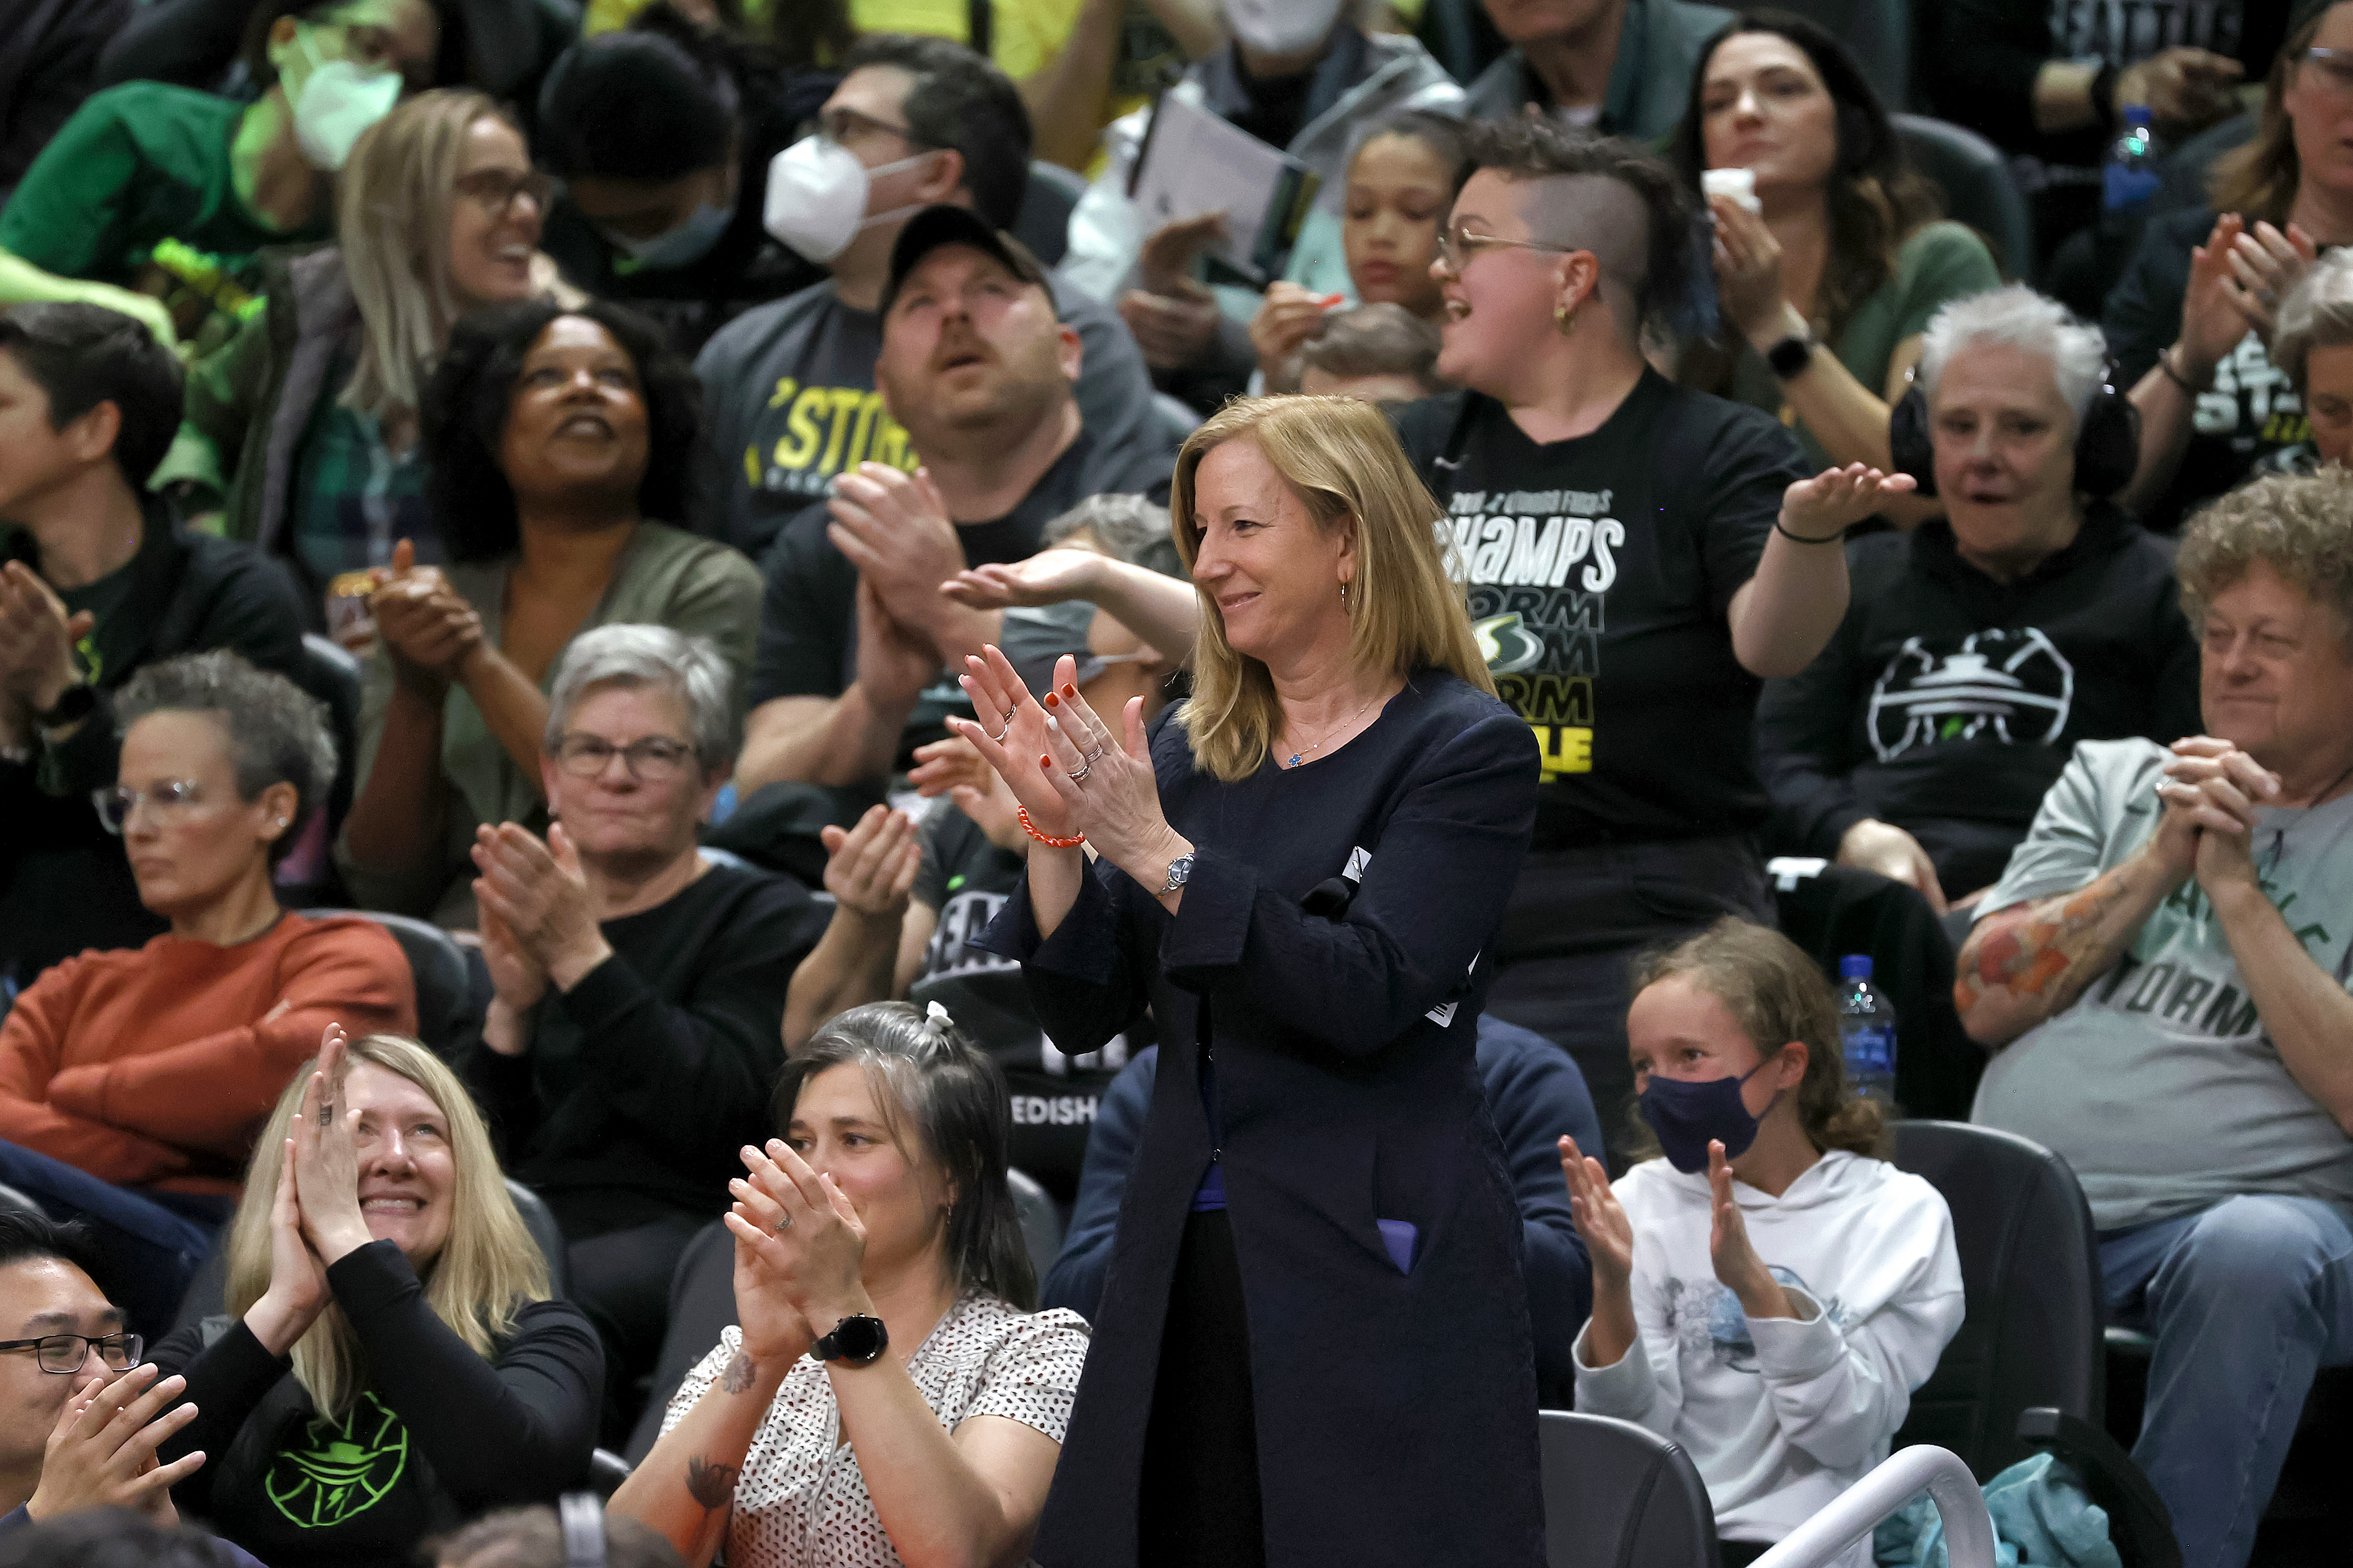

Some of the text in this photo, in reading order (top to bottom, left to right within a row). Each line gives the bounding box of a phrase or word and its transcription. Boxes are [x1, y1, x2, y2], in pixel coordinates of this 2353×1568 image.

[1466, 585, 1605, 634] ORM
[1493, 673, 1595, 726] RM
[1531, 726, 1594, 774] LE
[2098, 950, 2260, 1037] TORM
[1010, 1094, 1098, 1126] EDISH
